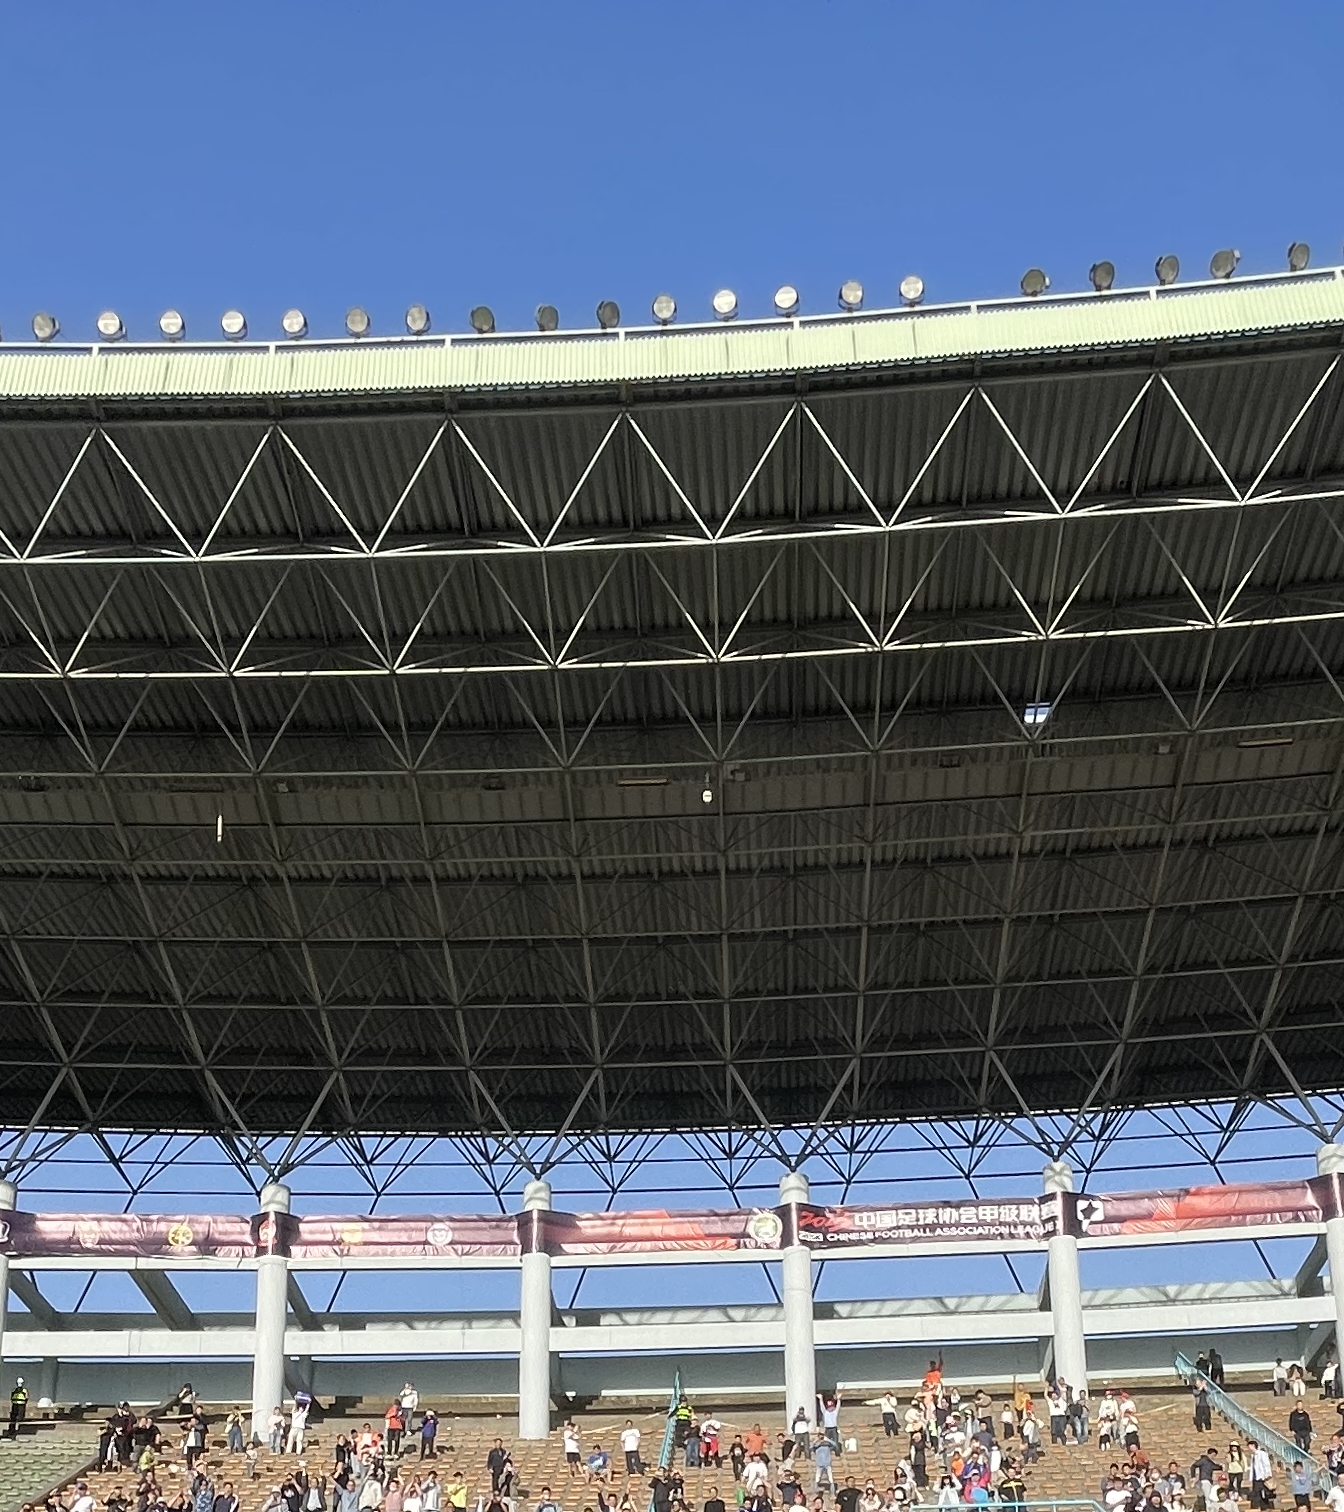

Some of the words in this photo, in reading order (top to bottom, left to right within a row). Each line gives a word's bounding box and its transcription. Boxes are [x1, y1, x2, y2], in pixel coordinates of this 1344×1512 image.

[827, 1231, 874, 1242] CHINESE
[875, 1227, 934, 1239] FOOTBALL
[934, 1224, 1010, 1237] ASSOCIATION
